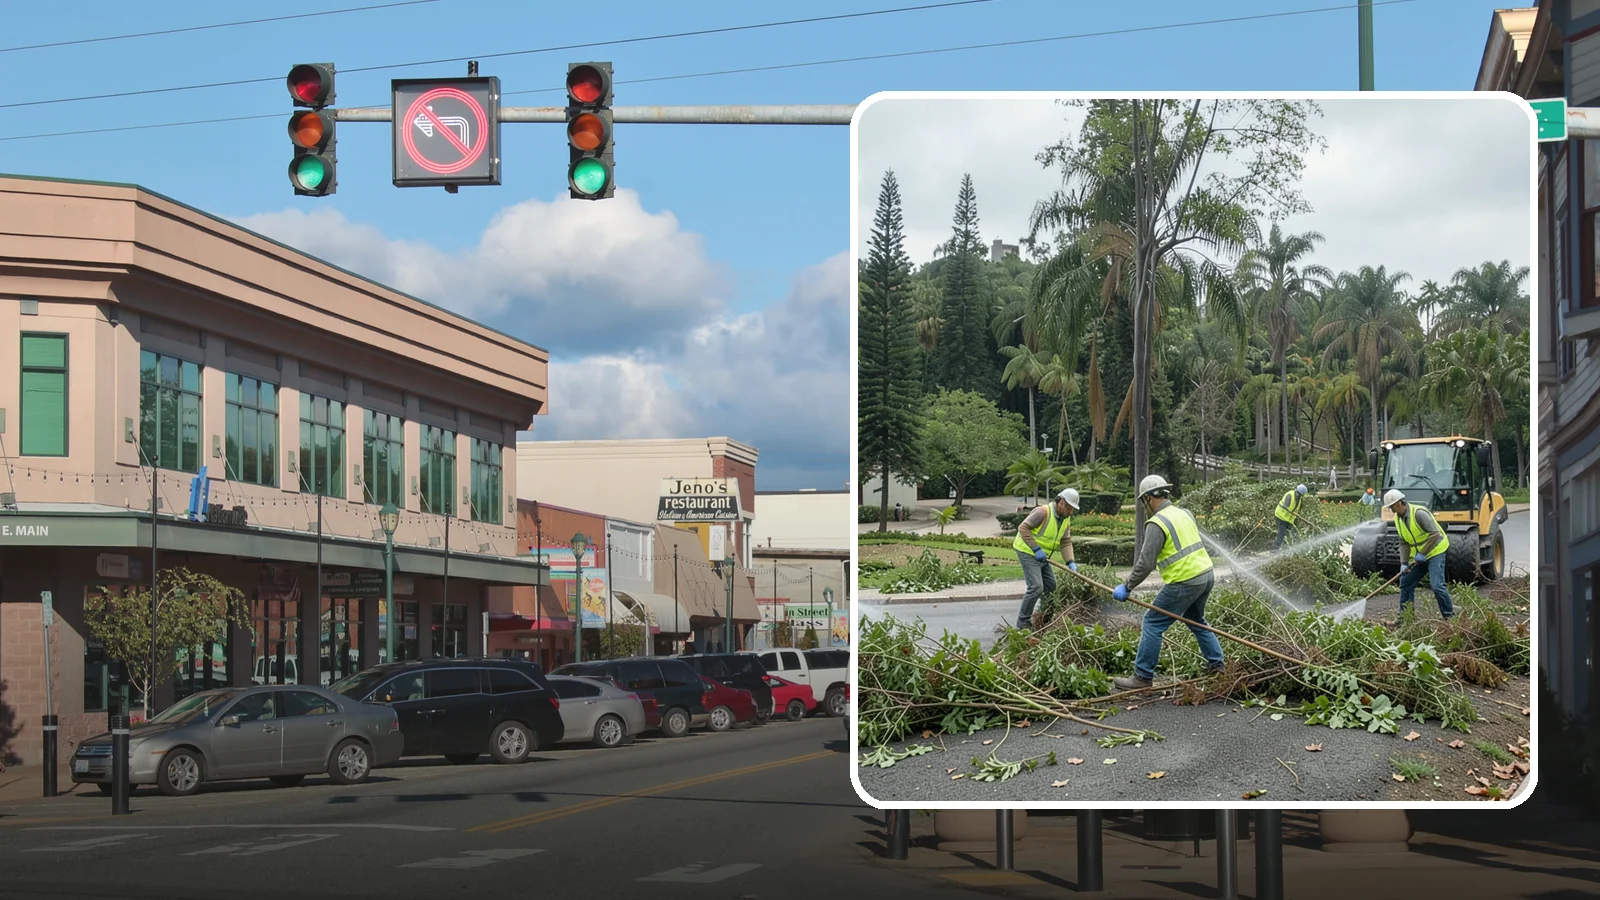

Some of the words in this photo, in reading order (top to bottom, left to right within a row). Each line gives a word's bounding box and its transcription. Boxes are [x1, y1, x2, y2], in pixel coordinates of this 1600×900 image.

[669, 479, 728, 495] Jeno's
[665, 496, 731, 509] restaurant
[686, 509, 715, 520] American
[715, 509, 738, 520] Cuisine
[2, 525, 13, 536] E.
[15, 525, 49, 536] MAIN
[797, 607, 829, 617] Street
